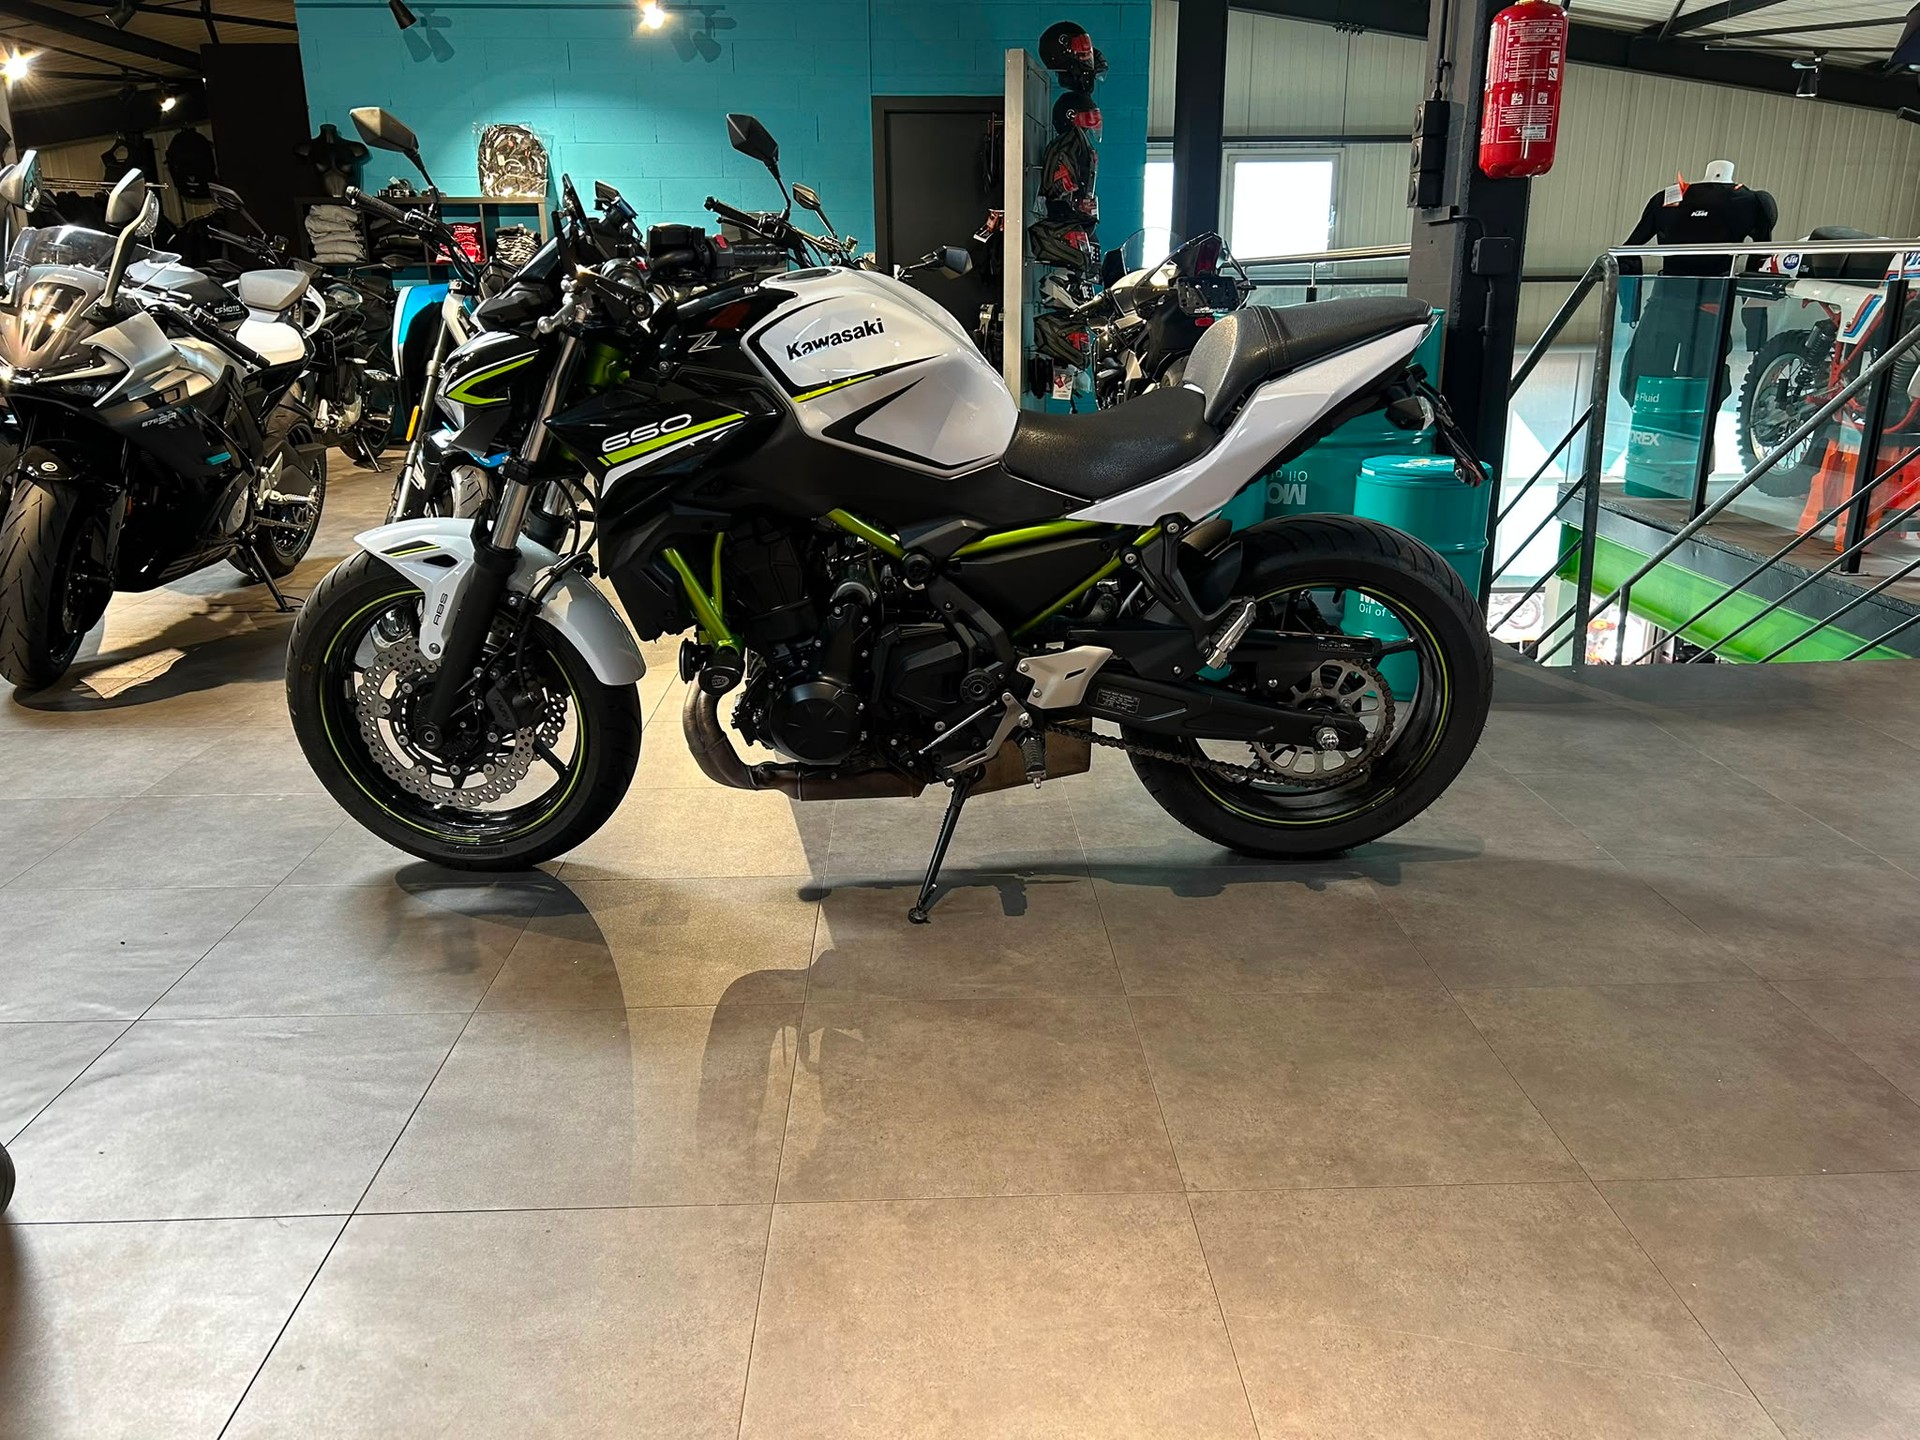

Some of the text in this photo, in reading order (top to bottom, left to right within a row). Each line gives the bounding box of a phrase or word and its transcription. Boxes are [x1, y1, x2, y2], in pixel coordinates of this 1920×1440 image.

[786, 317, 885, 361] Kawasaki
[1640, 392, 1660, 403] Fluid
[602, 413, 692, 452] 650
[433, 592, 449, 626] ABS
[1359, 603, 1372, 614] Oil
[1374, 607, 1387, 617] of
